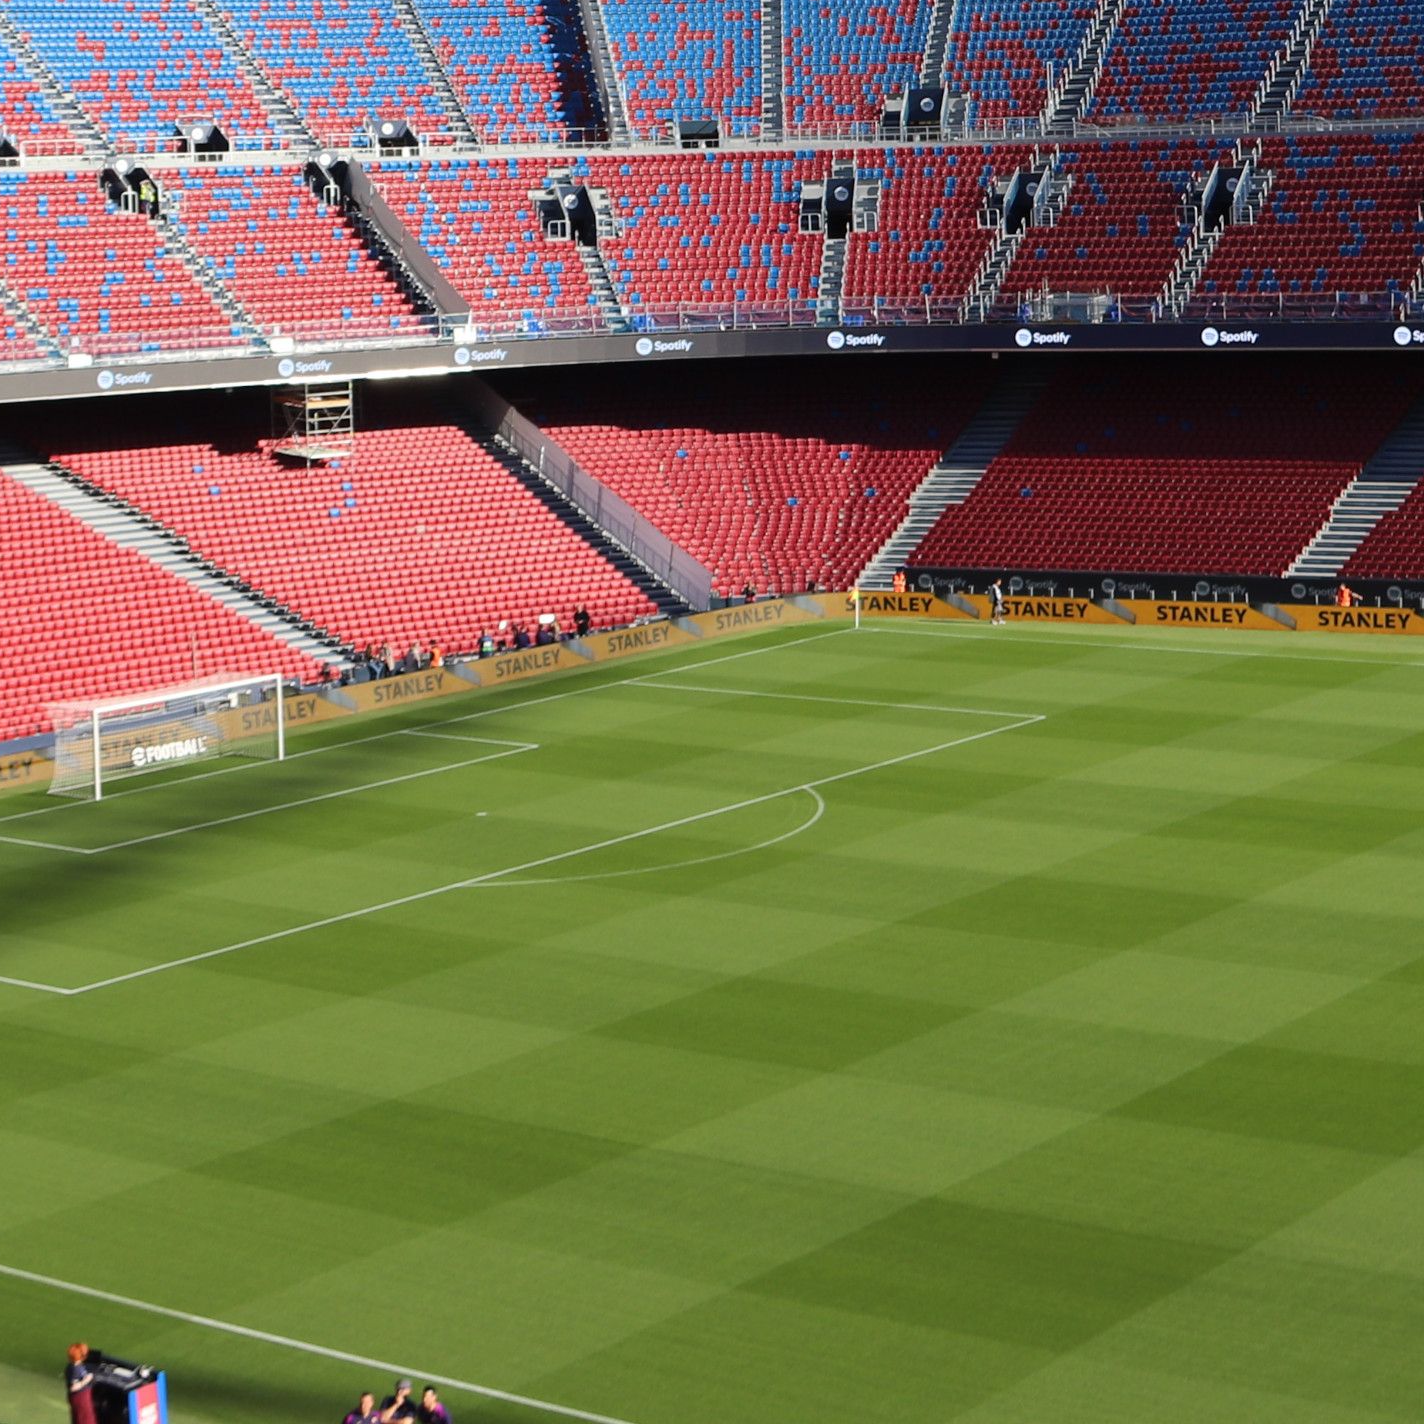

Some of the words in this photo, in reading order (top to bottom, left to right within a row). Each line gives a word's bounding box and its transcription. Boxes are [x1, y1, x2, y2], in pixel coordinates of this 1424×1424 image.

[846, 333, 885, 348] Spotify
[1033, 331, 1071, 345] Spotify
[1219, 330, 1258, 344] Spotify
[470, 347, 508, 363] Spotify
[654, 339, 693, 354] Spotify
[295, 359, 333, 375] Spotify
[115, 371, 153, 387] Spotify
[717, 602, 784, 631] STANLEY
[1000, 600, 1088, 620] STANLEY
[1156, 605, 1247, 624] STANLEY
[1318, 611, 1410, 630] STANLEY
[607, 621, 670, 653] STANLEY
[495, 649, 561, 677] STANLEY
[373, 674, 444, 702] STANLEY
